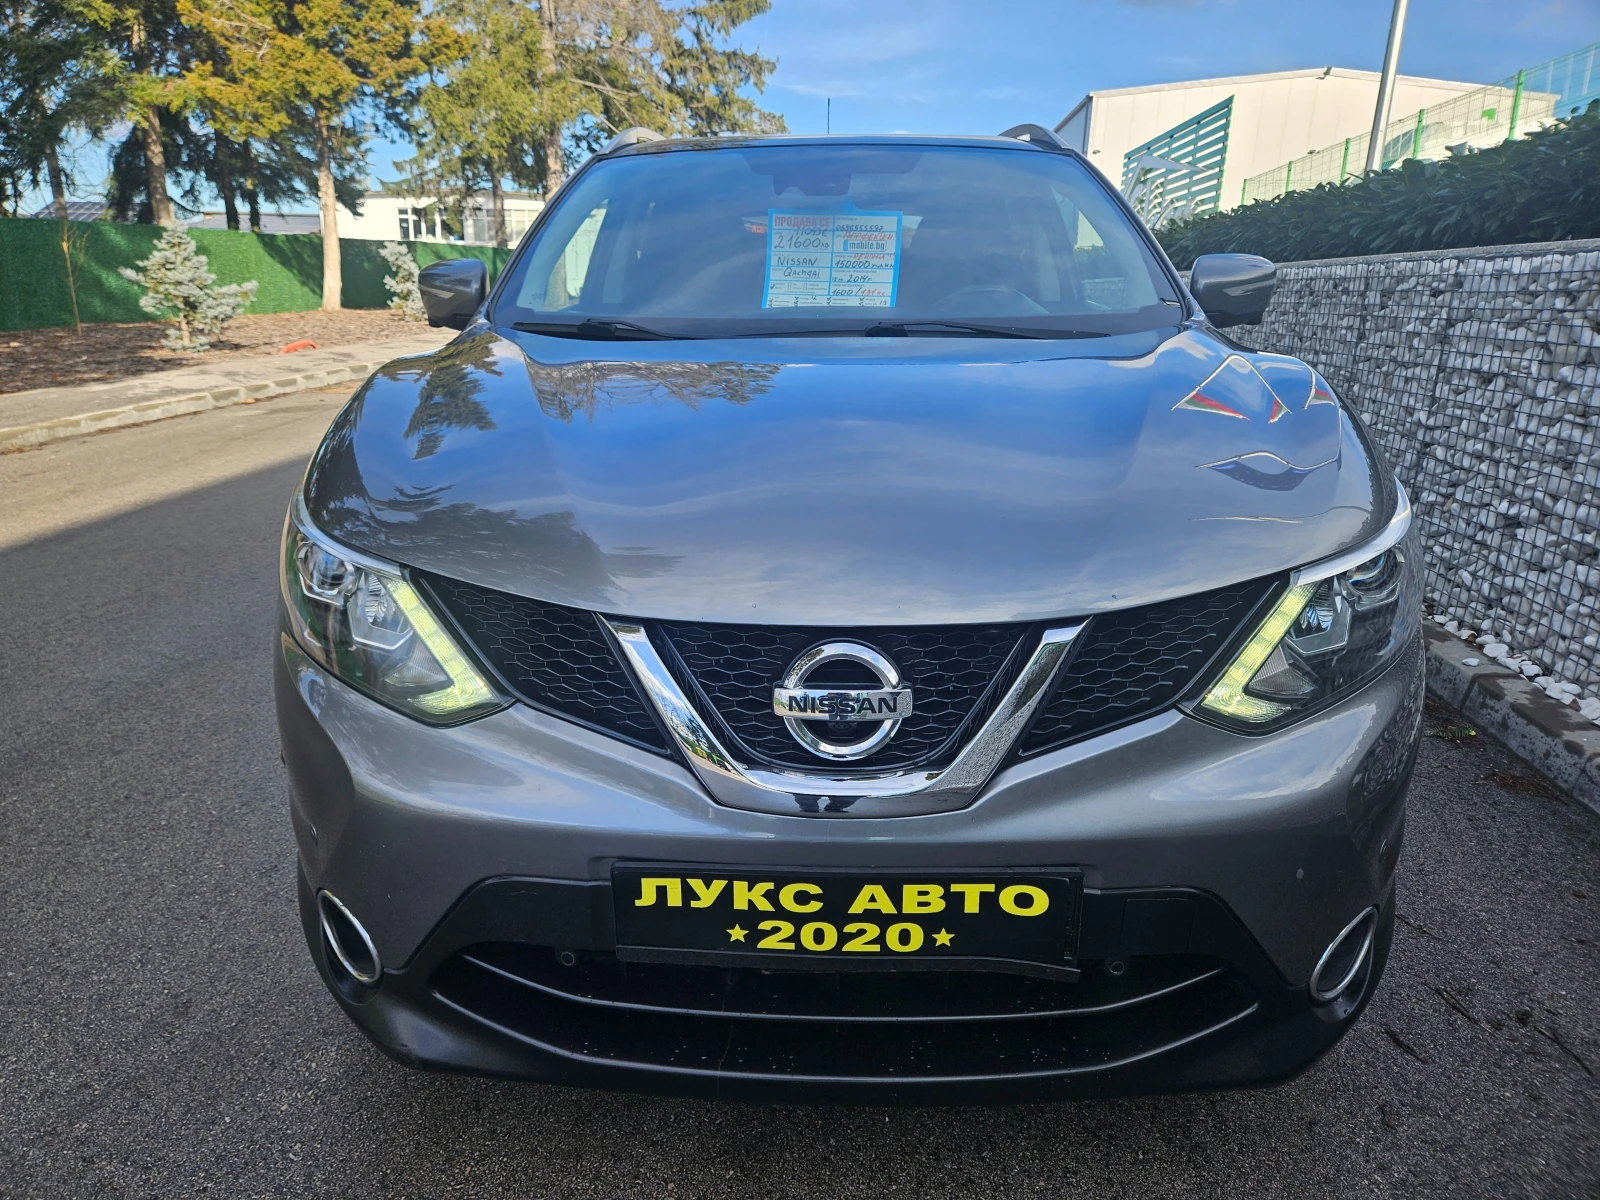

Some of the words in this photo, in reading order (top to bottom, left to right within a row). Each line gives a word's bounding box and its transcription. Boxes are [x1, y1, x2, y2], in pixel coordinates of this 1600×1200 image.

[774, 216, 816, 228] ПРОДАВА
[819, 217, 831, 227] СЕ
[849, 241, 885, 250] mobile.bg
[788, 695, 897, 714] NISSAN
[634, 877, 824, 914] ЛУКС
[847, 883, 1050, 917] АВТО
[756, 920, 925, 952] 2020
